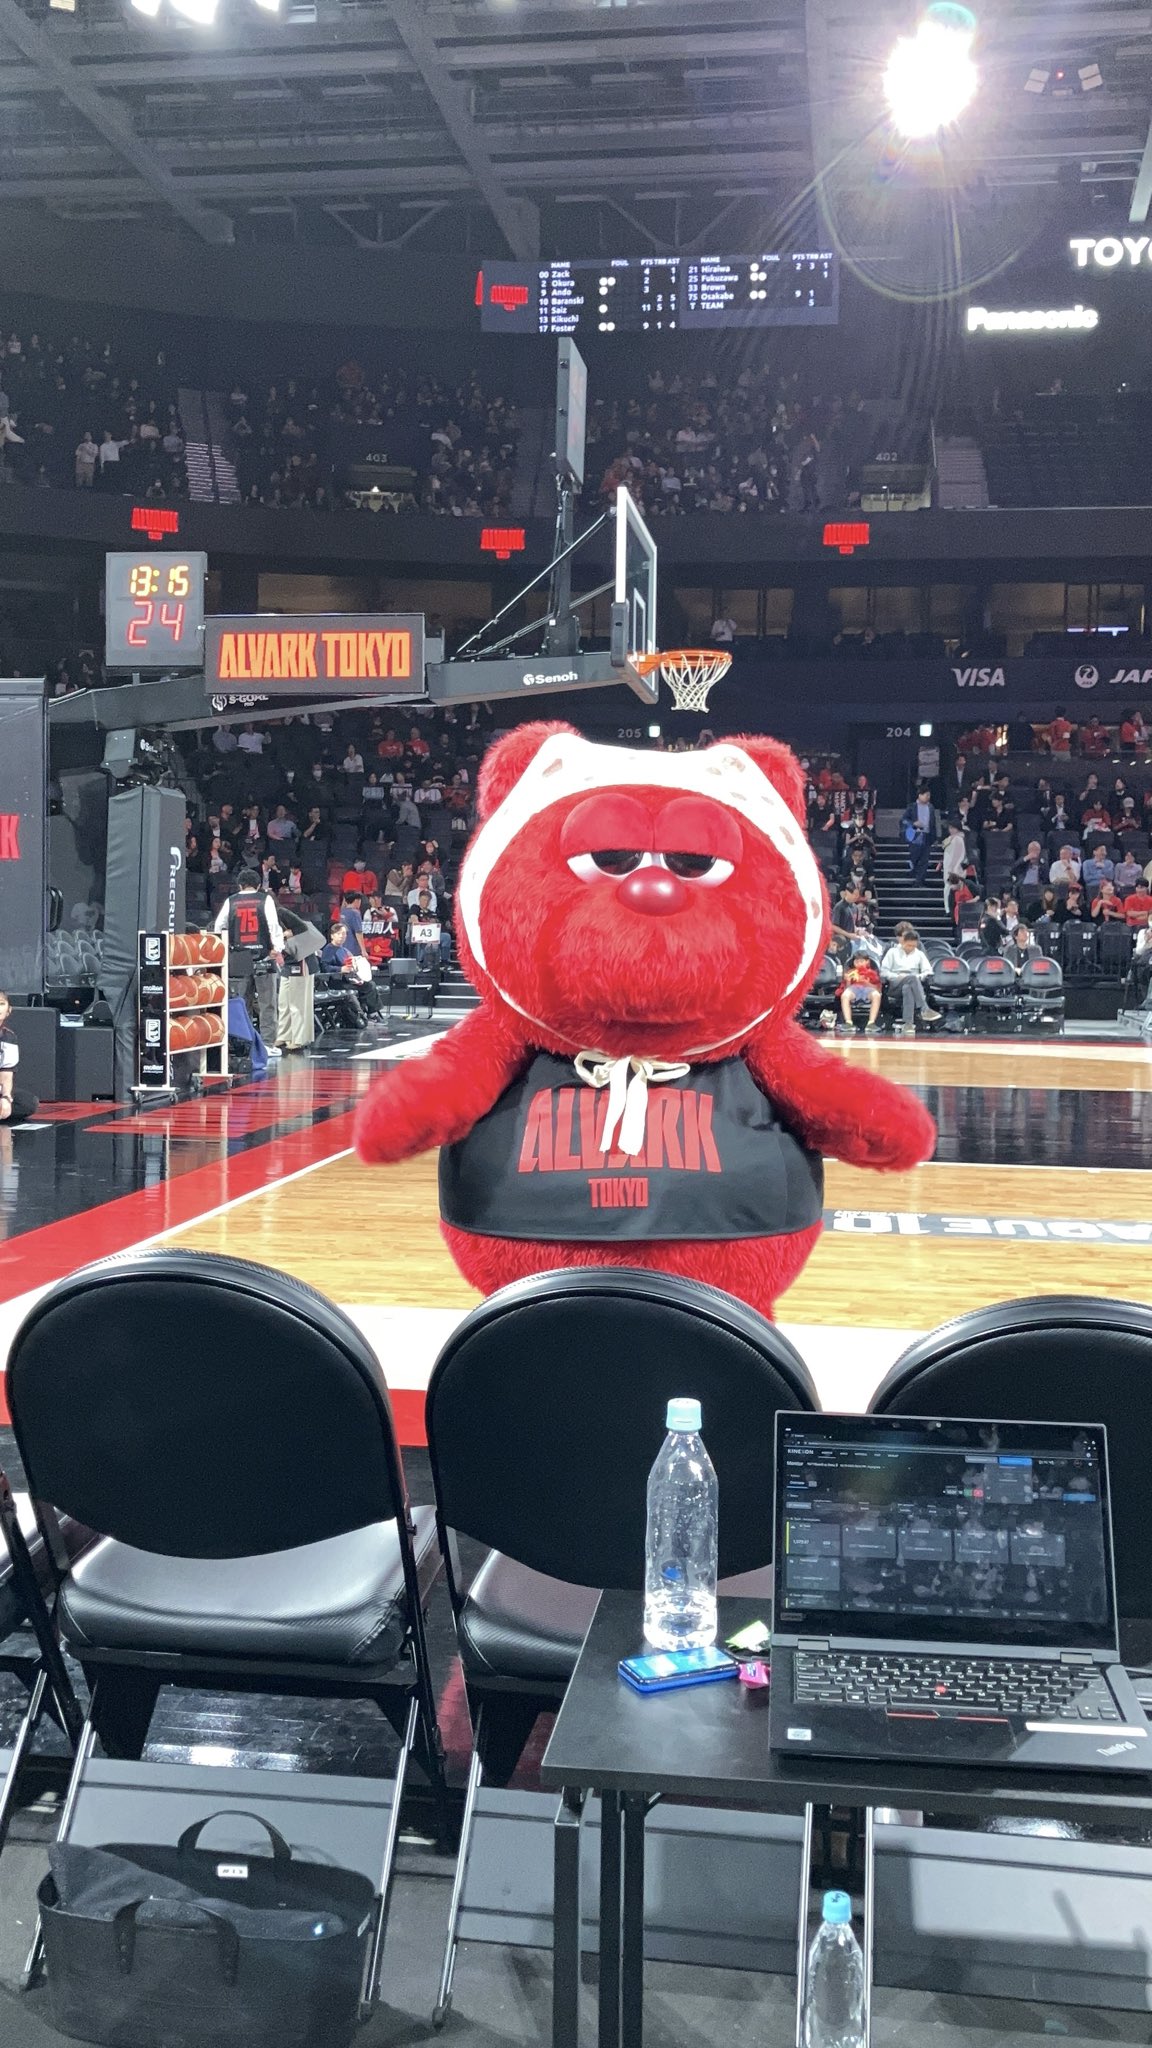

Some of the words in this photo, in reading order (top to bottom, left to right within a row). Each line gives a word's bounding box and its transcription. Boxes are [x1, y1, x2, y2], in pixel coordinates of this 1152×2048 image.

[1069, 236, 1152, 267] TOY
[701, 265, 731, 273] Hiraiwa
[551, 270, 570, 278] Zack
[701, 274, 739, 282] Fukuzawa
[551, 279, 575, 287] Okura
[551, 288, 572, 296] Ando
[688, 284, 698, 292] 33
[688, 293, 698, 301] 75
[701, 292, 734, 300] Osakabe
[538, 298, 549, 306] 10
[551, 297, 584, 305] Baranski
[551, 306, 567, 314] Saiz
[551, 315, 579, 323] Kikuchi
[551, 324, 575, 332] Foster
[130, 566, 189, 596] 13:15
[128, 601, 183, 644] 24
[219, 633, 317, 678] ALVARK
[321, 632, 410, 677] TOKYO
[535, 671, 578, 684] Senoh
[951, 668, 1005, 687] VISA
[618, 728, 641, 738] 205
[886, 727, 911, 738] 204
[236, 907, 259, 933] 75
[420, 929, 432, 938] A3
[588, 1177, 648, 1208] TOKYO
